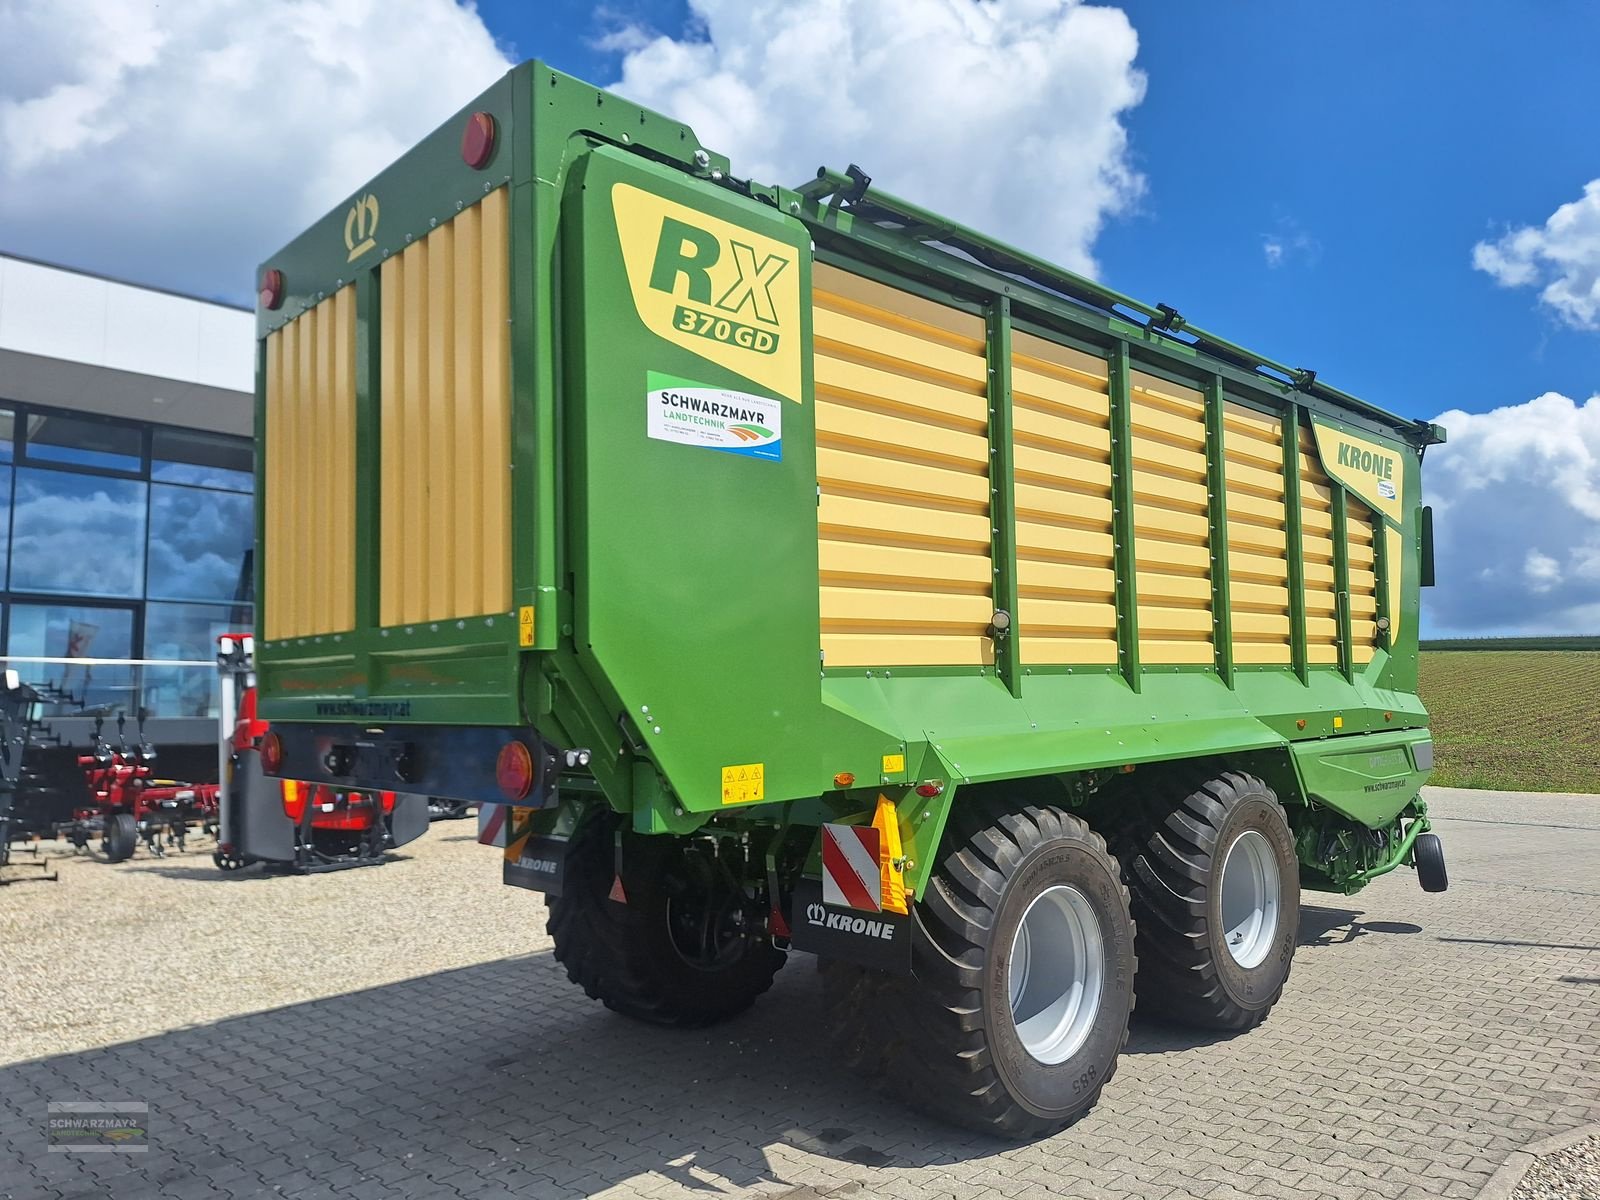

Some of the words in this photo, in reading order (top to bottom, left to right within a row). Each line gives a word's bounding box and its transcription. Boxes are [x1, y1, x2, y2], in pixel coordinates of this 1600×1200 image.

[649, 216, 789, 326] RX
[679, 311, 731, 340] 370
[734, 327, 774, 352] GD
[661, 392, 765, 424] SCHWARZMAYR
[663, 409, 726, 430] LANDTECHNIK
[1338, 442, 1393, 480] KRONE
[520, 856, 558, 874] KRONE
[826, 913, 895, 940] KRONE
